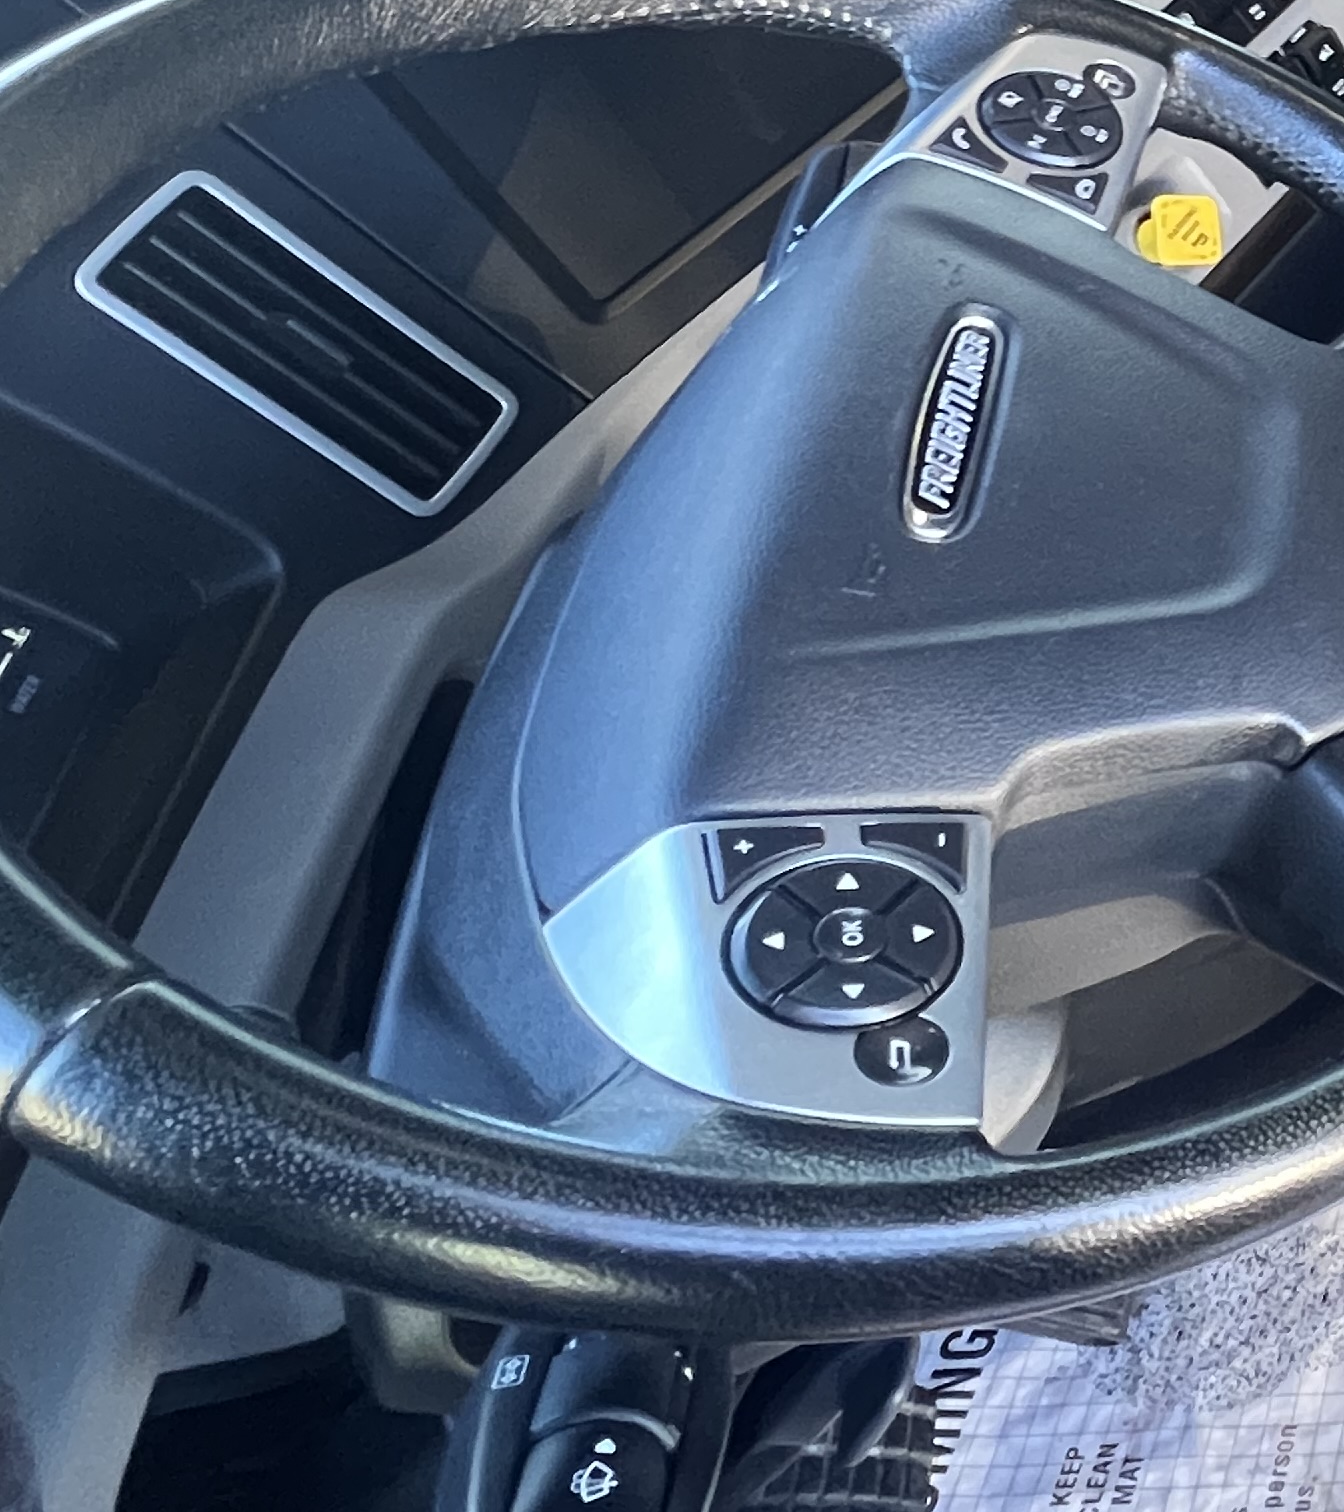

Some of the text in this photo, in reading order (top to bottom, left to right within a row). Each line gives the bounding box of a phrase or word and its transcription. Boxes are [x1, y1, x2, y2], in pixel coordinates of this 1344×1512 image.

[918, 329, 990, 509] FREIGHTLINER
[841, 919, 864, 947] OK
[1048, 1446, 1086, 1507] KEEP
[1110, 1454, 1145, 1505] MAT
[1264, 1423, 1298, 1508] person
